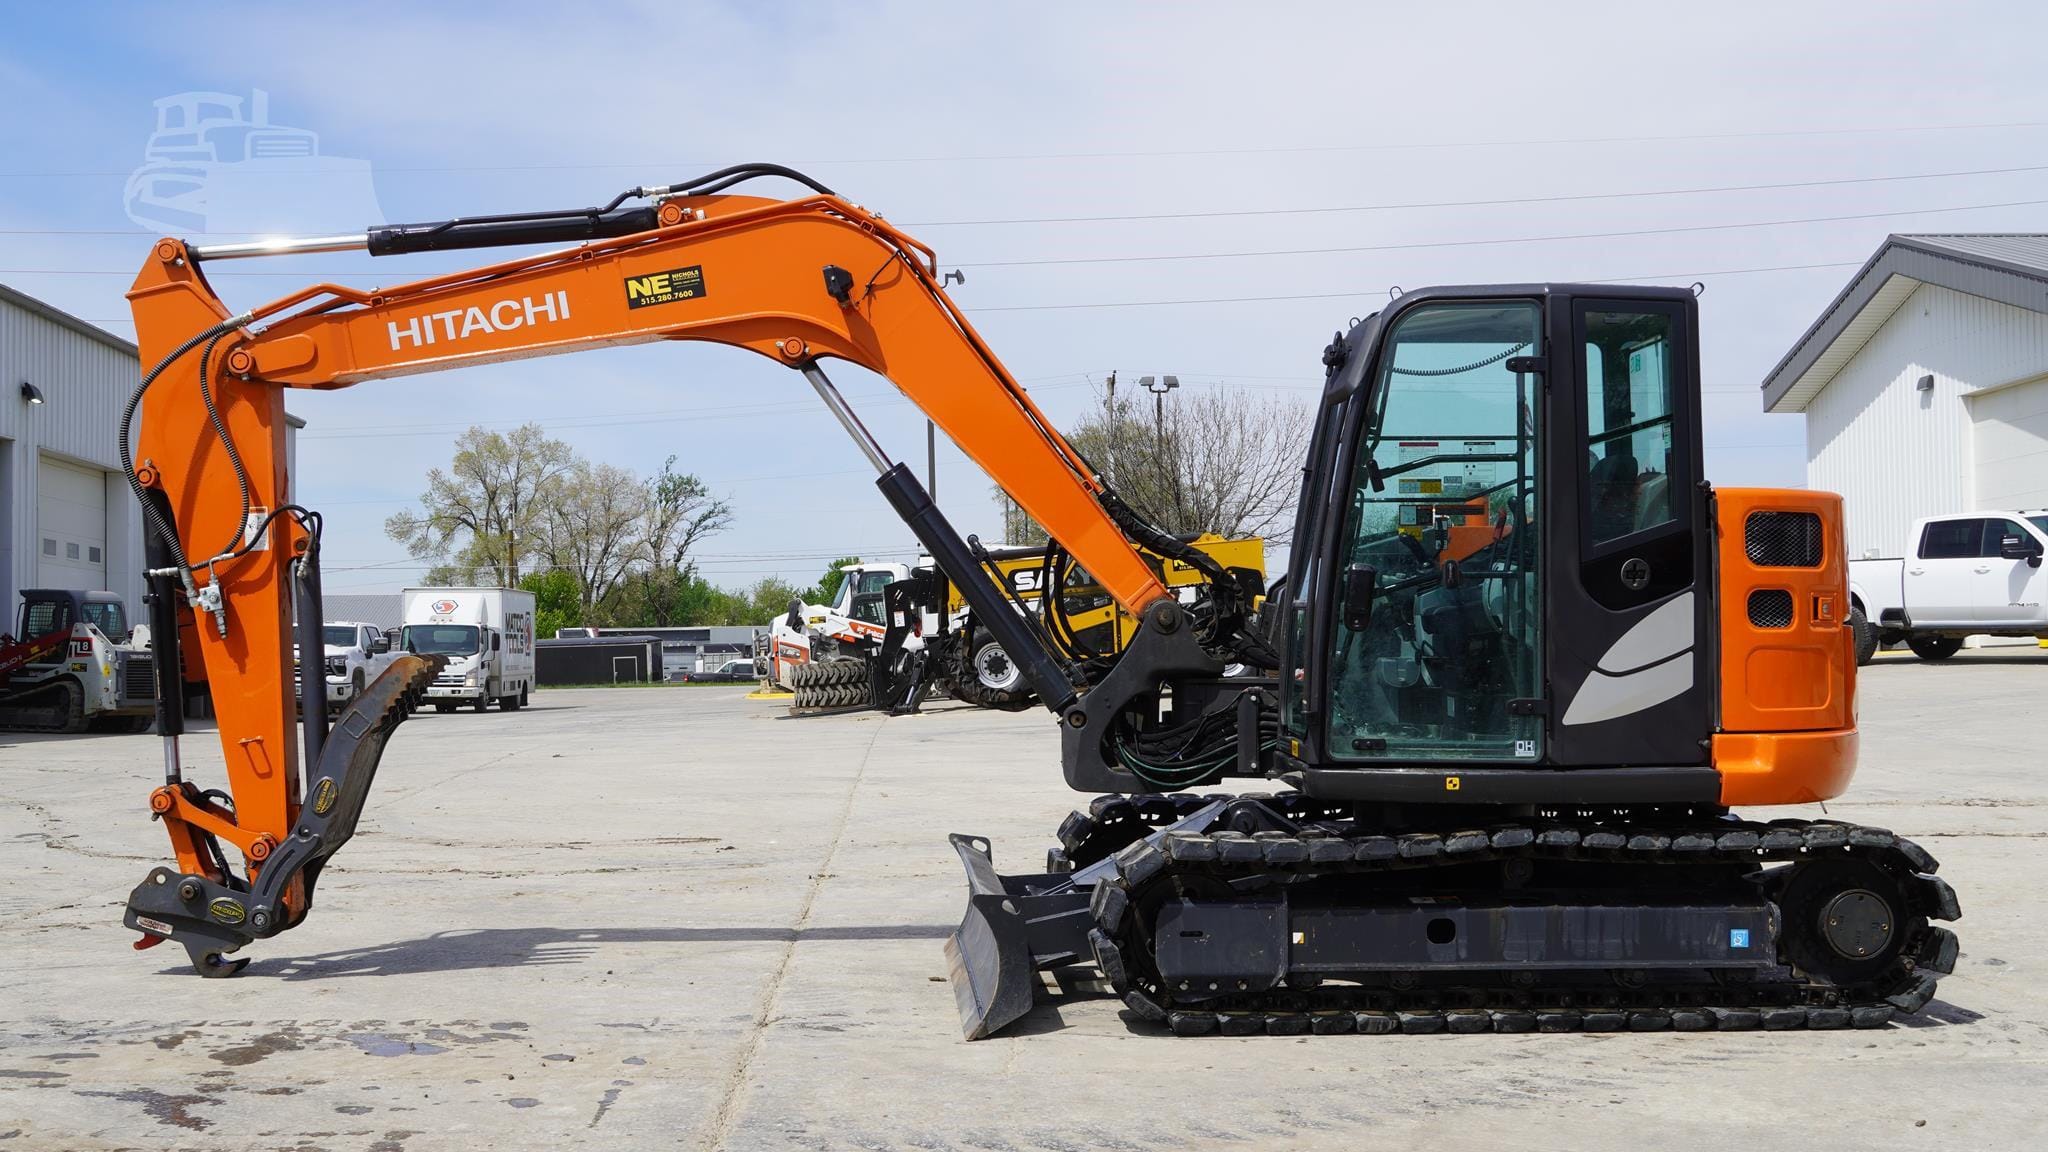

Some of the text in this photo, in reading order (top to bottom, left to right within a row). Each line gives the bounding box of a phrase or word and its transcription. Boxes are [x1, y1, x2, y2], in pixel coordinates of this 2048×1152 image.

[672, 270, 699, 280] NICHOLS
[627, 273, 672, 299] NE
[641, 289, 694, 305] 515.280.7600
[387, 290, 571, 351] HITACHI
[505, 613, 523, 632] MATCO
[69, 640, 93, 658] TL8
[505, 634, 523, 654] TOOLS
